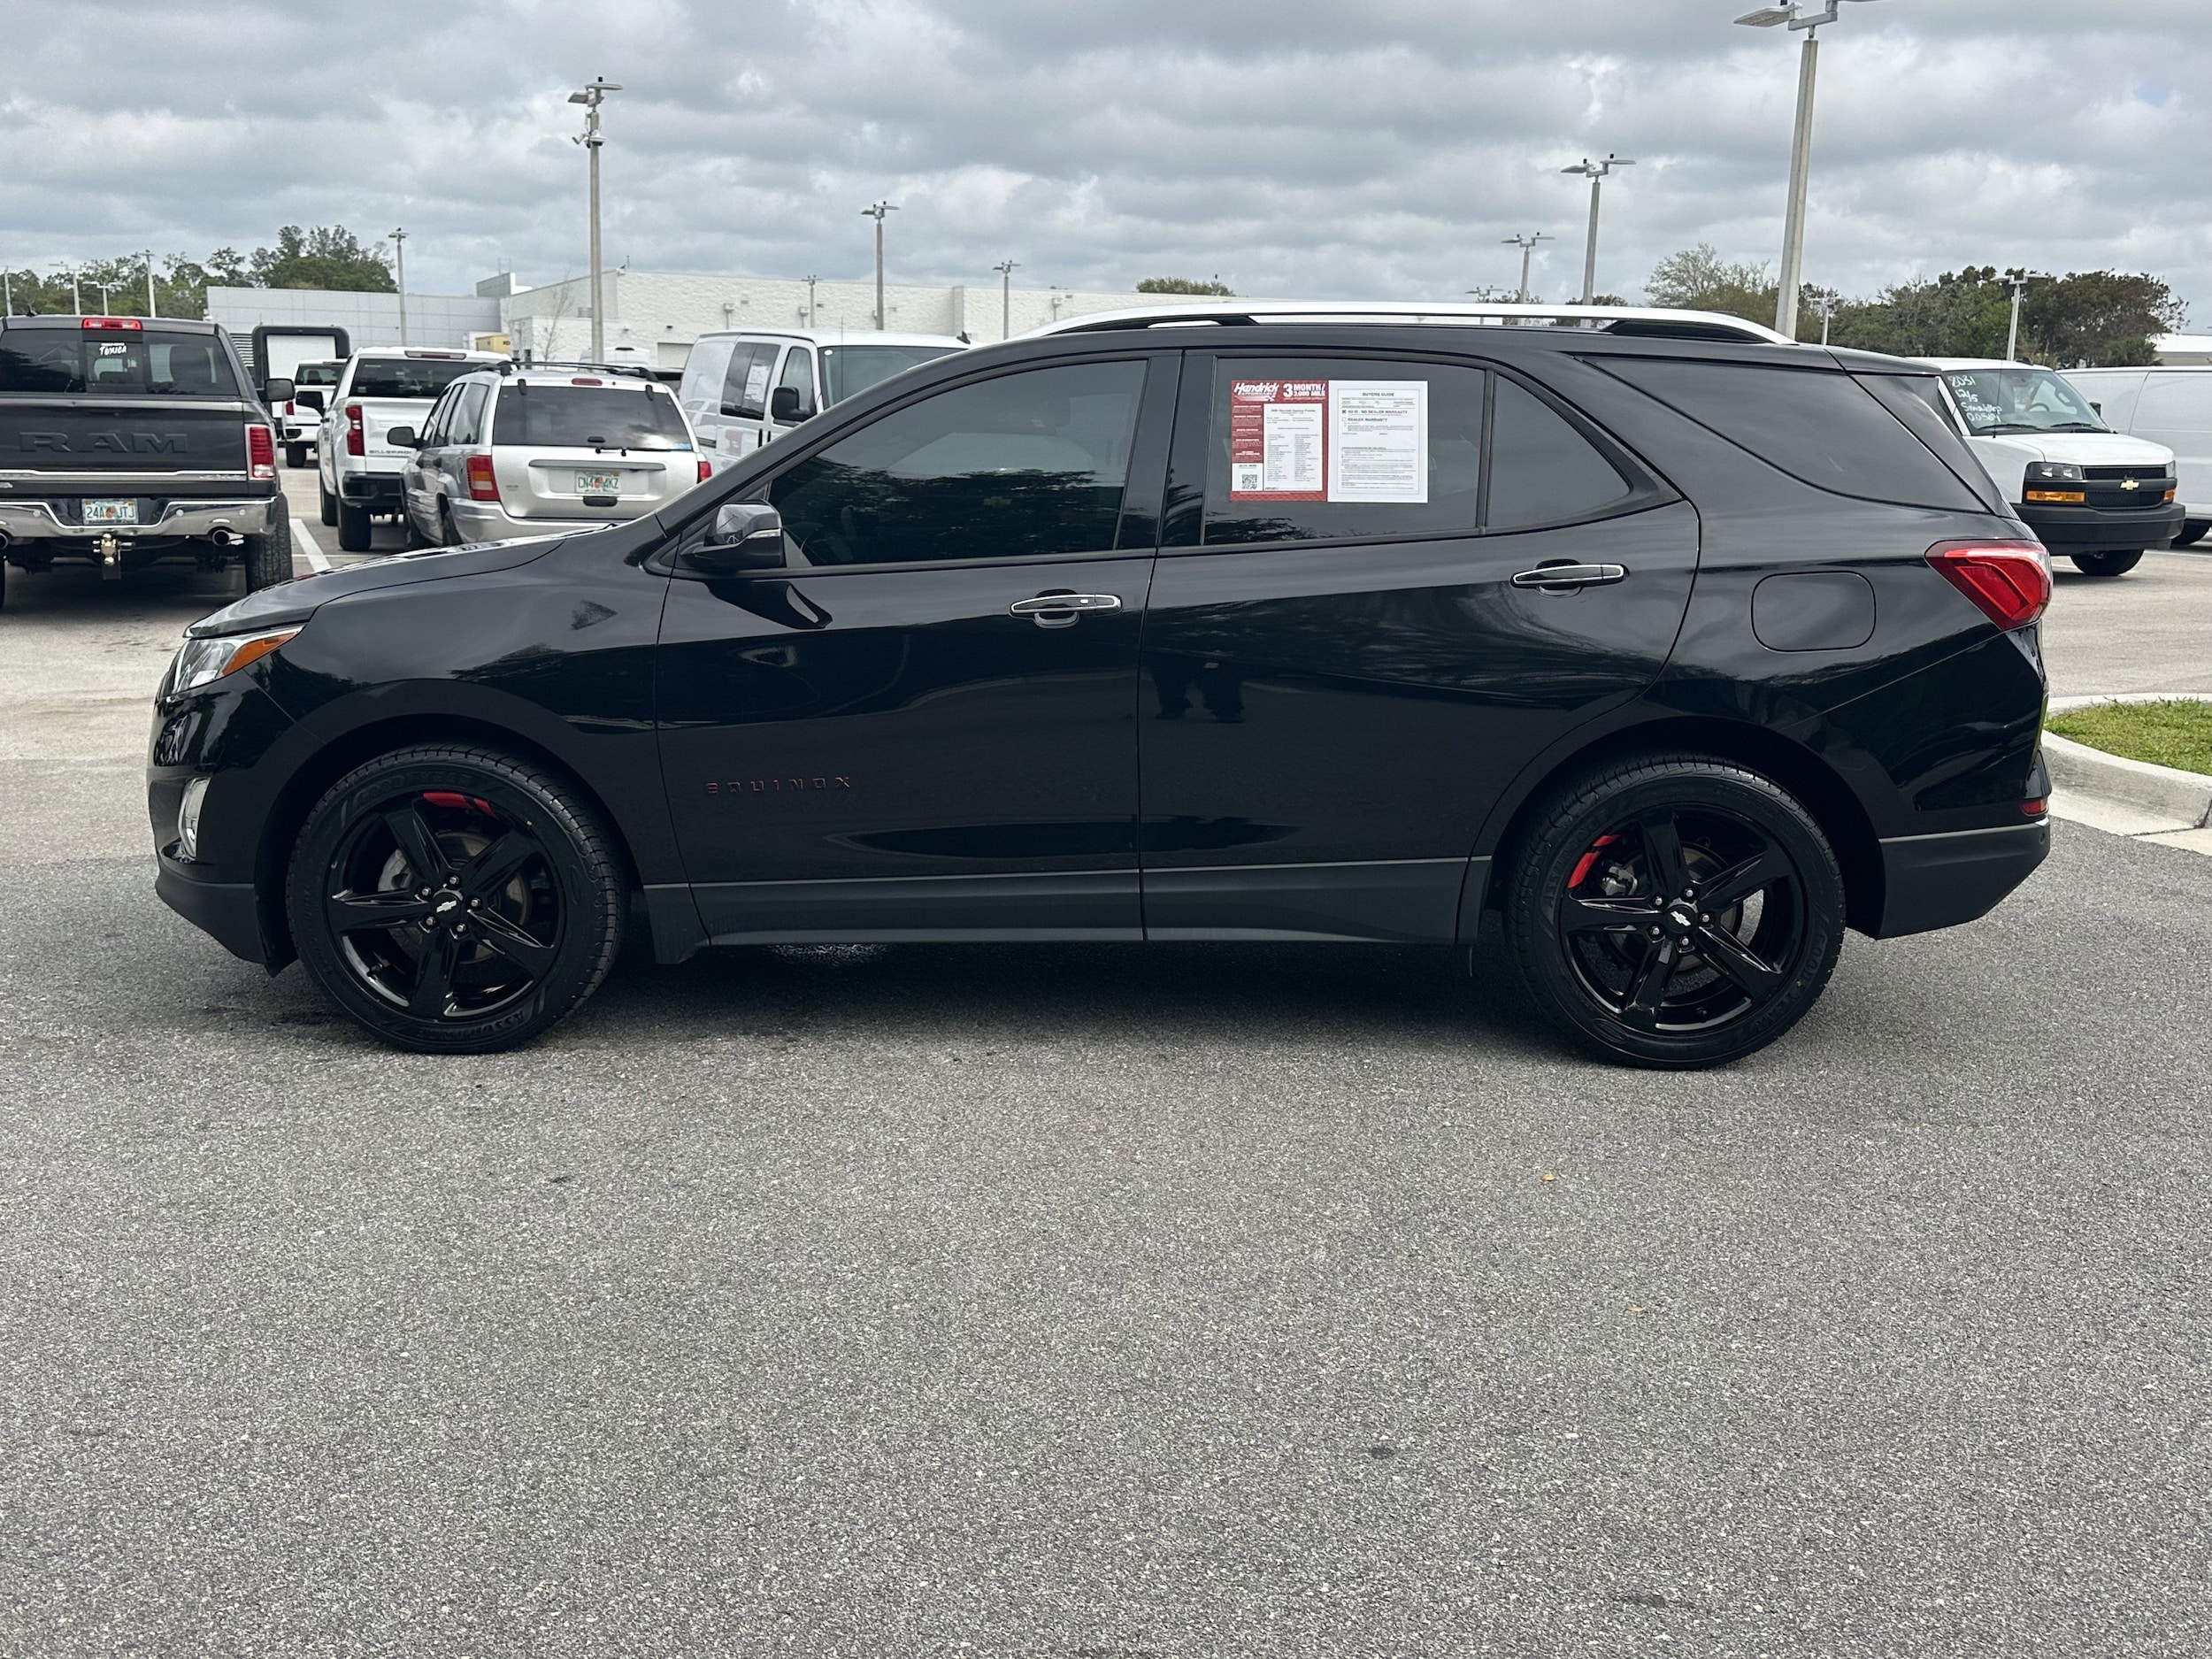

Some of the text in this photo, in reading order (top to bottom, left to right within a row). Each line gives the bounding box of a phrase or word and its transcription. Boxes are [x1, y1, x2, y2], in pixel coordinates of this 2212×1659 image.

[1233, 382, 1279, 396] Hendrick
[1283, 382, 1293, 397] 3
[19, 432, 188, 453] RAM
[705, 776, 850, 794] EQUINOX
